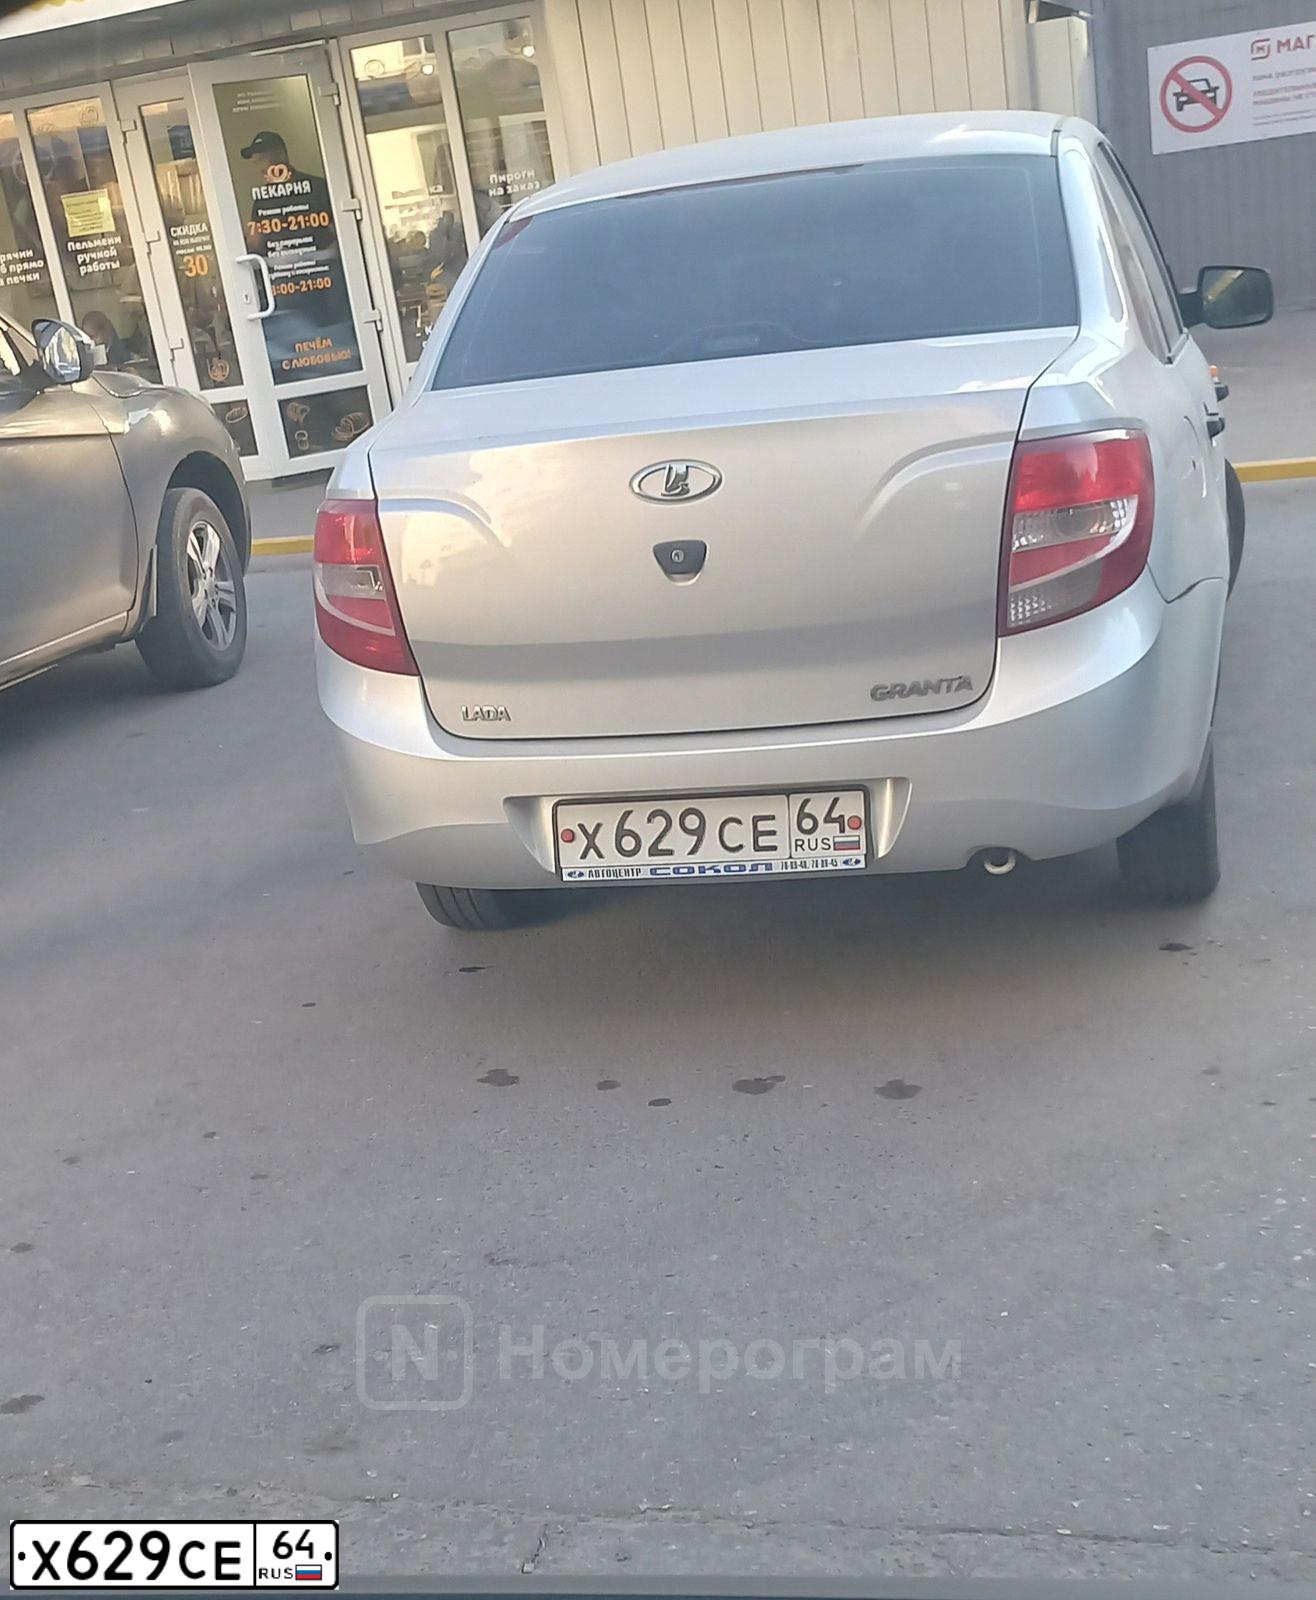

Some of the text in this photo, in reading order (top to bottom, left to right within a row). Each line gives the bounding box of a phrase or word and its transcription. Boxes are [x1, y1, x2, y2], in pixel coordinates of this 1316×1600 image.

[1277, 34, 1315, 53] МАГ
[489, 169, 535, 184] Пироги
[252, 180, 311, 200] ПЕКАРНЯ
[488, 181, 540, 197] на заказ
[170, 222, 208, 237] СКИДКА
[247, 211, 329, 236] 7:30-21:00
[67, 236, 121, 251] Пельмени
[77, 246, 117, 264] ручной
[9, 259, 44, 274] прямо
[79, 260, 119, 276] работы
[7, 272, 40, 285] печки
[295, 337, 332, 352] ПЕЧЁМ
[870, 675, 973, 701] GRANTA
[461, 704, 511, 721] LADA
[796, 797, 845, 834] 64
[794, 838, 831, 851] RUS
[588, 867, 642, 878] АВТОЦЕНТР
[650, 862, 773, 876] СОКОЛ
